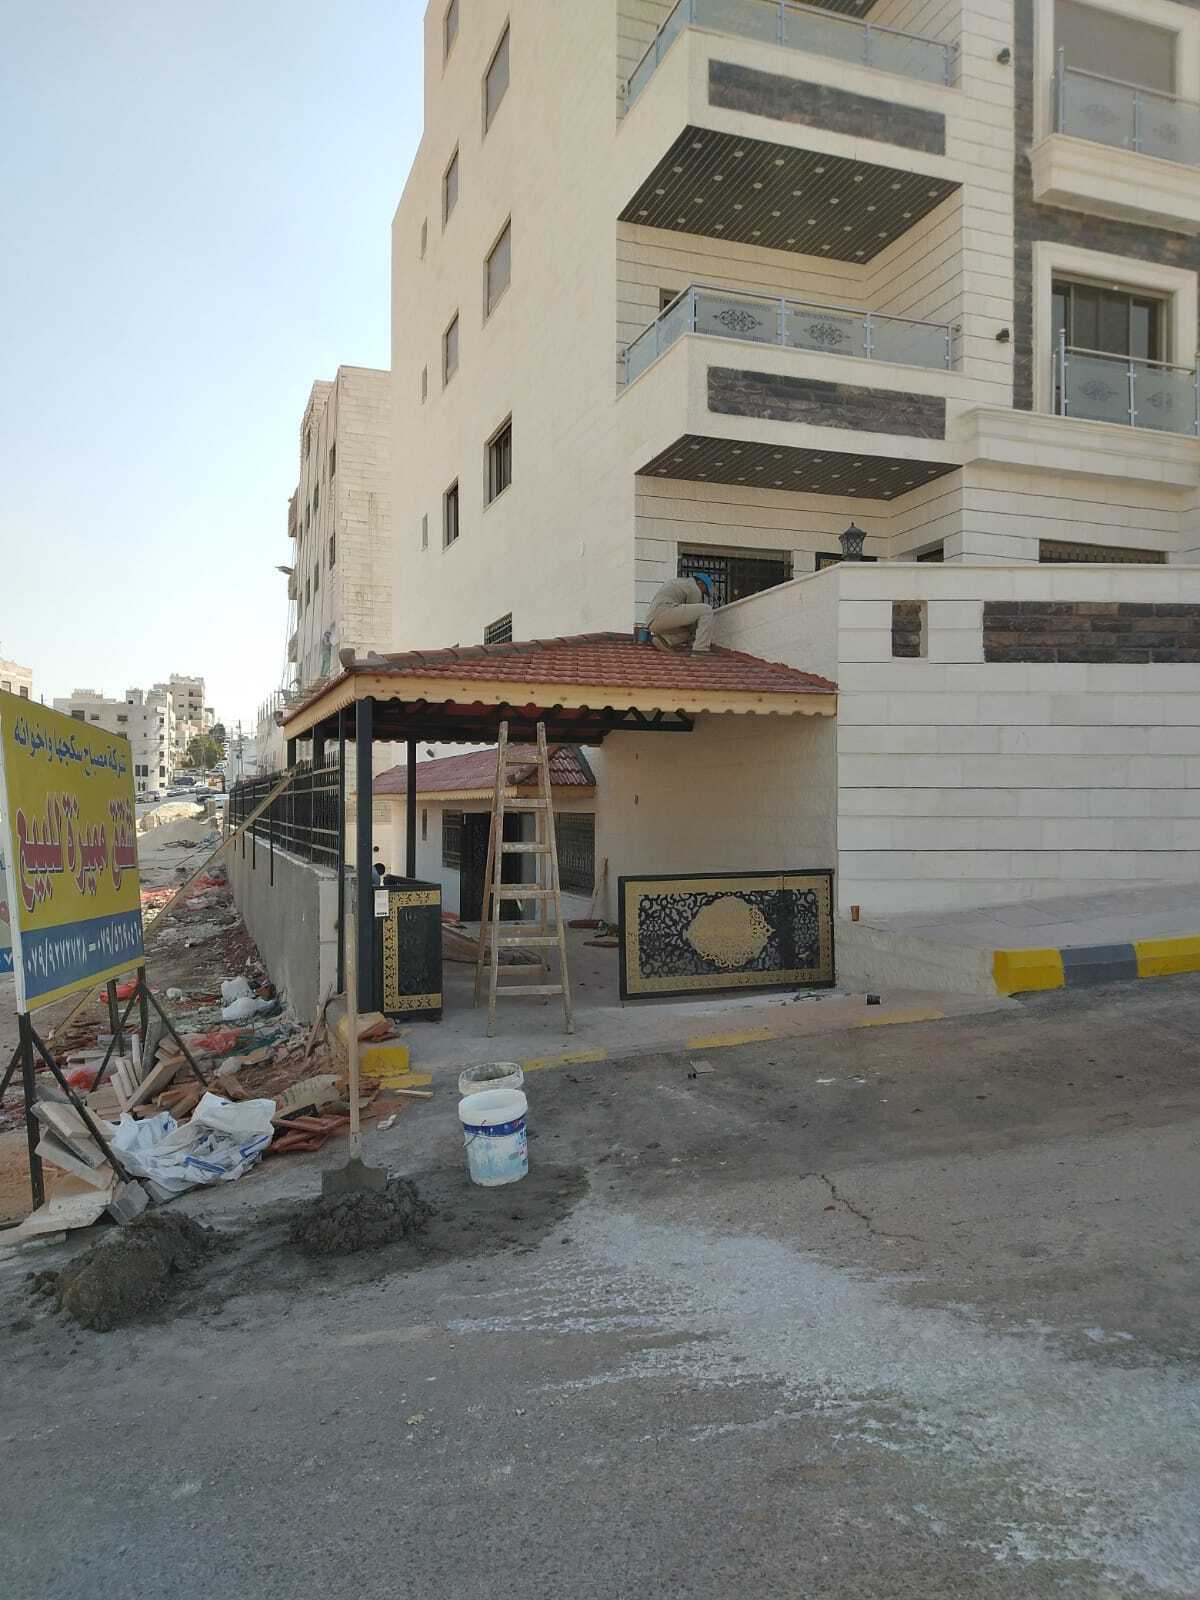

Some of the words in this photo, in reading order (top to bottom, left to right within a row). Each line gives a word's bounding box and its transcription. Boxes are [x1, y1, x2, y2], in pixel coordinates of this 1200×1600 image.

[16, 791, 63, 913] للبيع
[63, 793, 108, 896] مميزة
[108, 797, 136, 891] شقق
